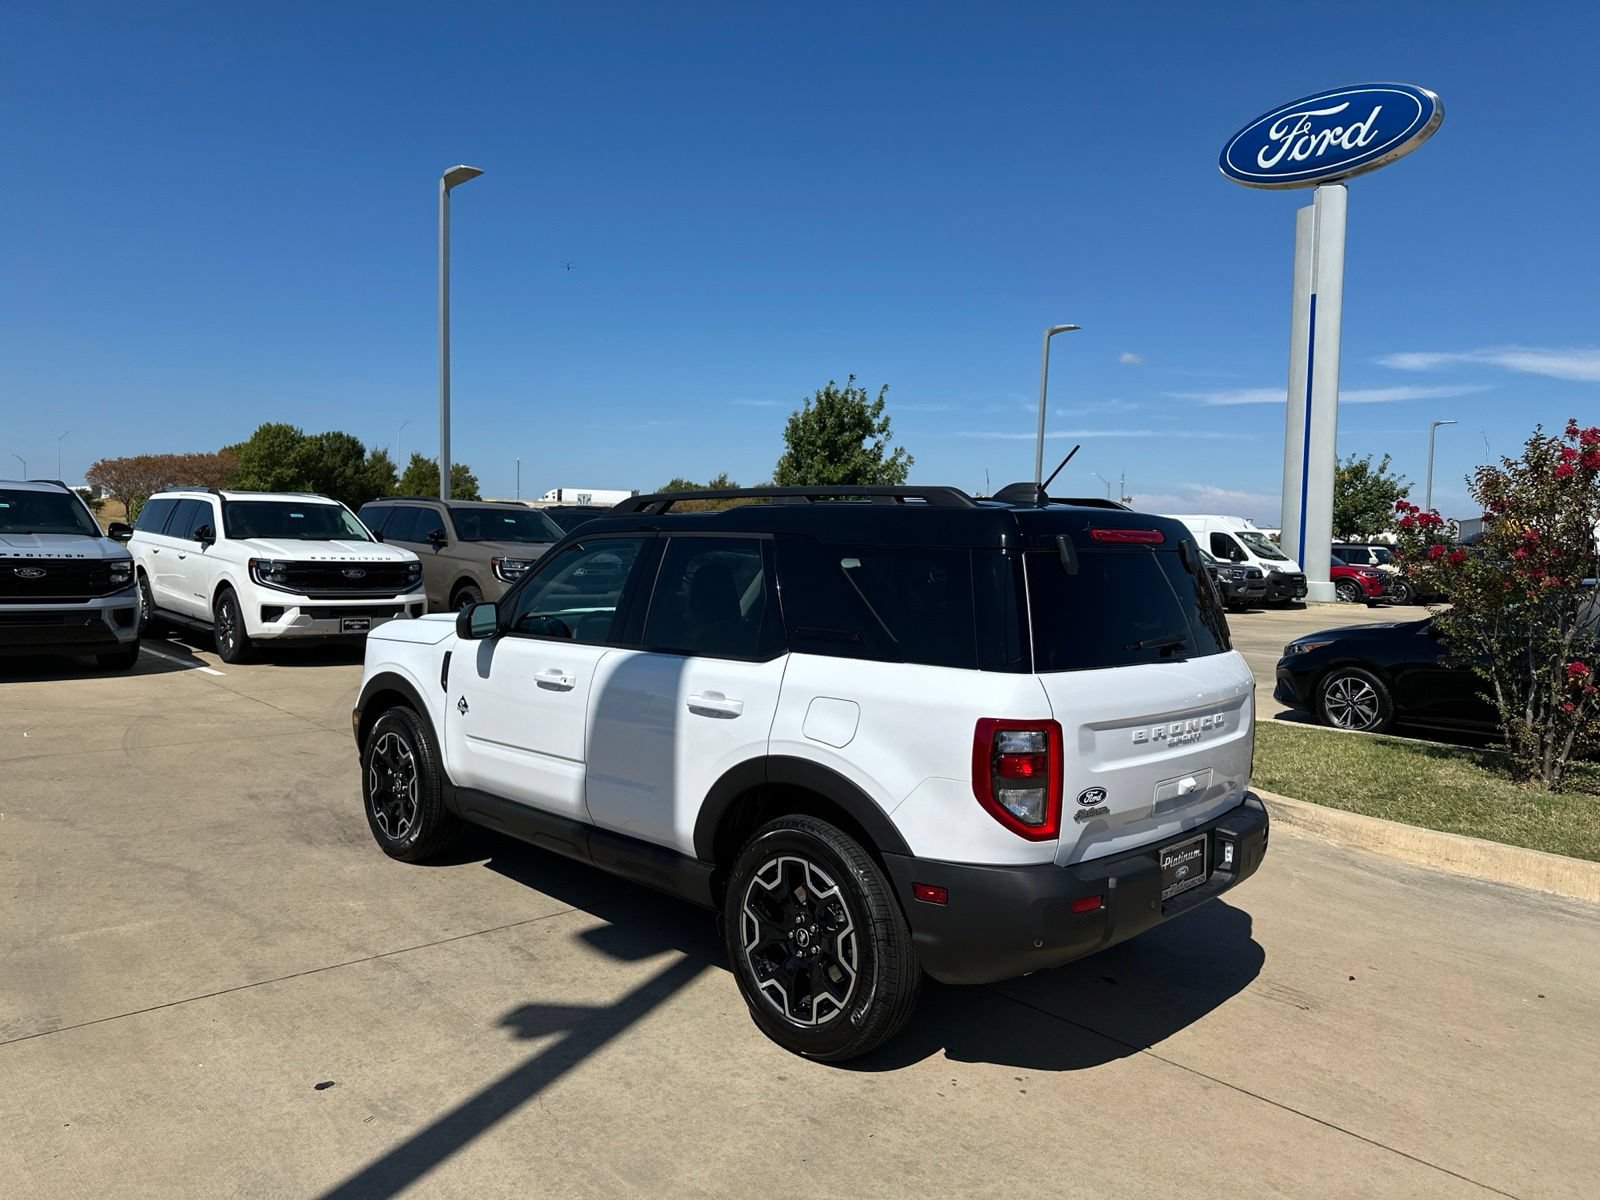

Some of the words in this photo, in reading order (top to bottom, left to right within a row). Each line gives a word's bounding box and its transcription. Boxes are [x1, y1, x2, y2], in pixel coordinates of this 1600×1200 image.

[1257, 101, 1383, 169] Ford
[1132, 712, 1225, 744] BRONCO
[1167, 731, 1202, 747] SPORT
[1083, 790, 1104, 803] Ford
[1161, 849, 1203, 870] Platinum
